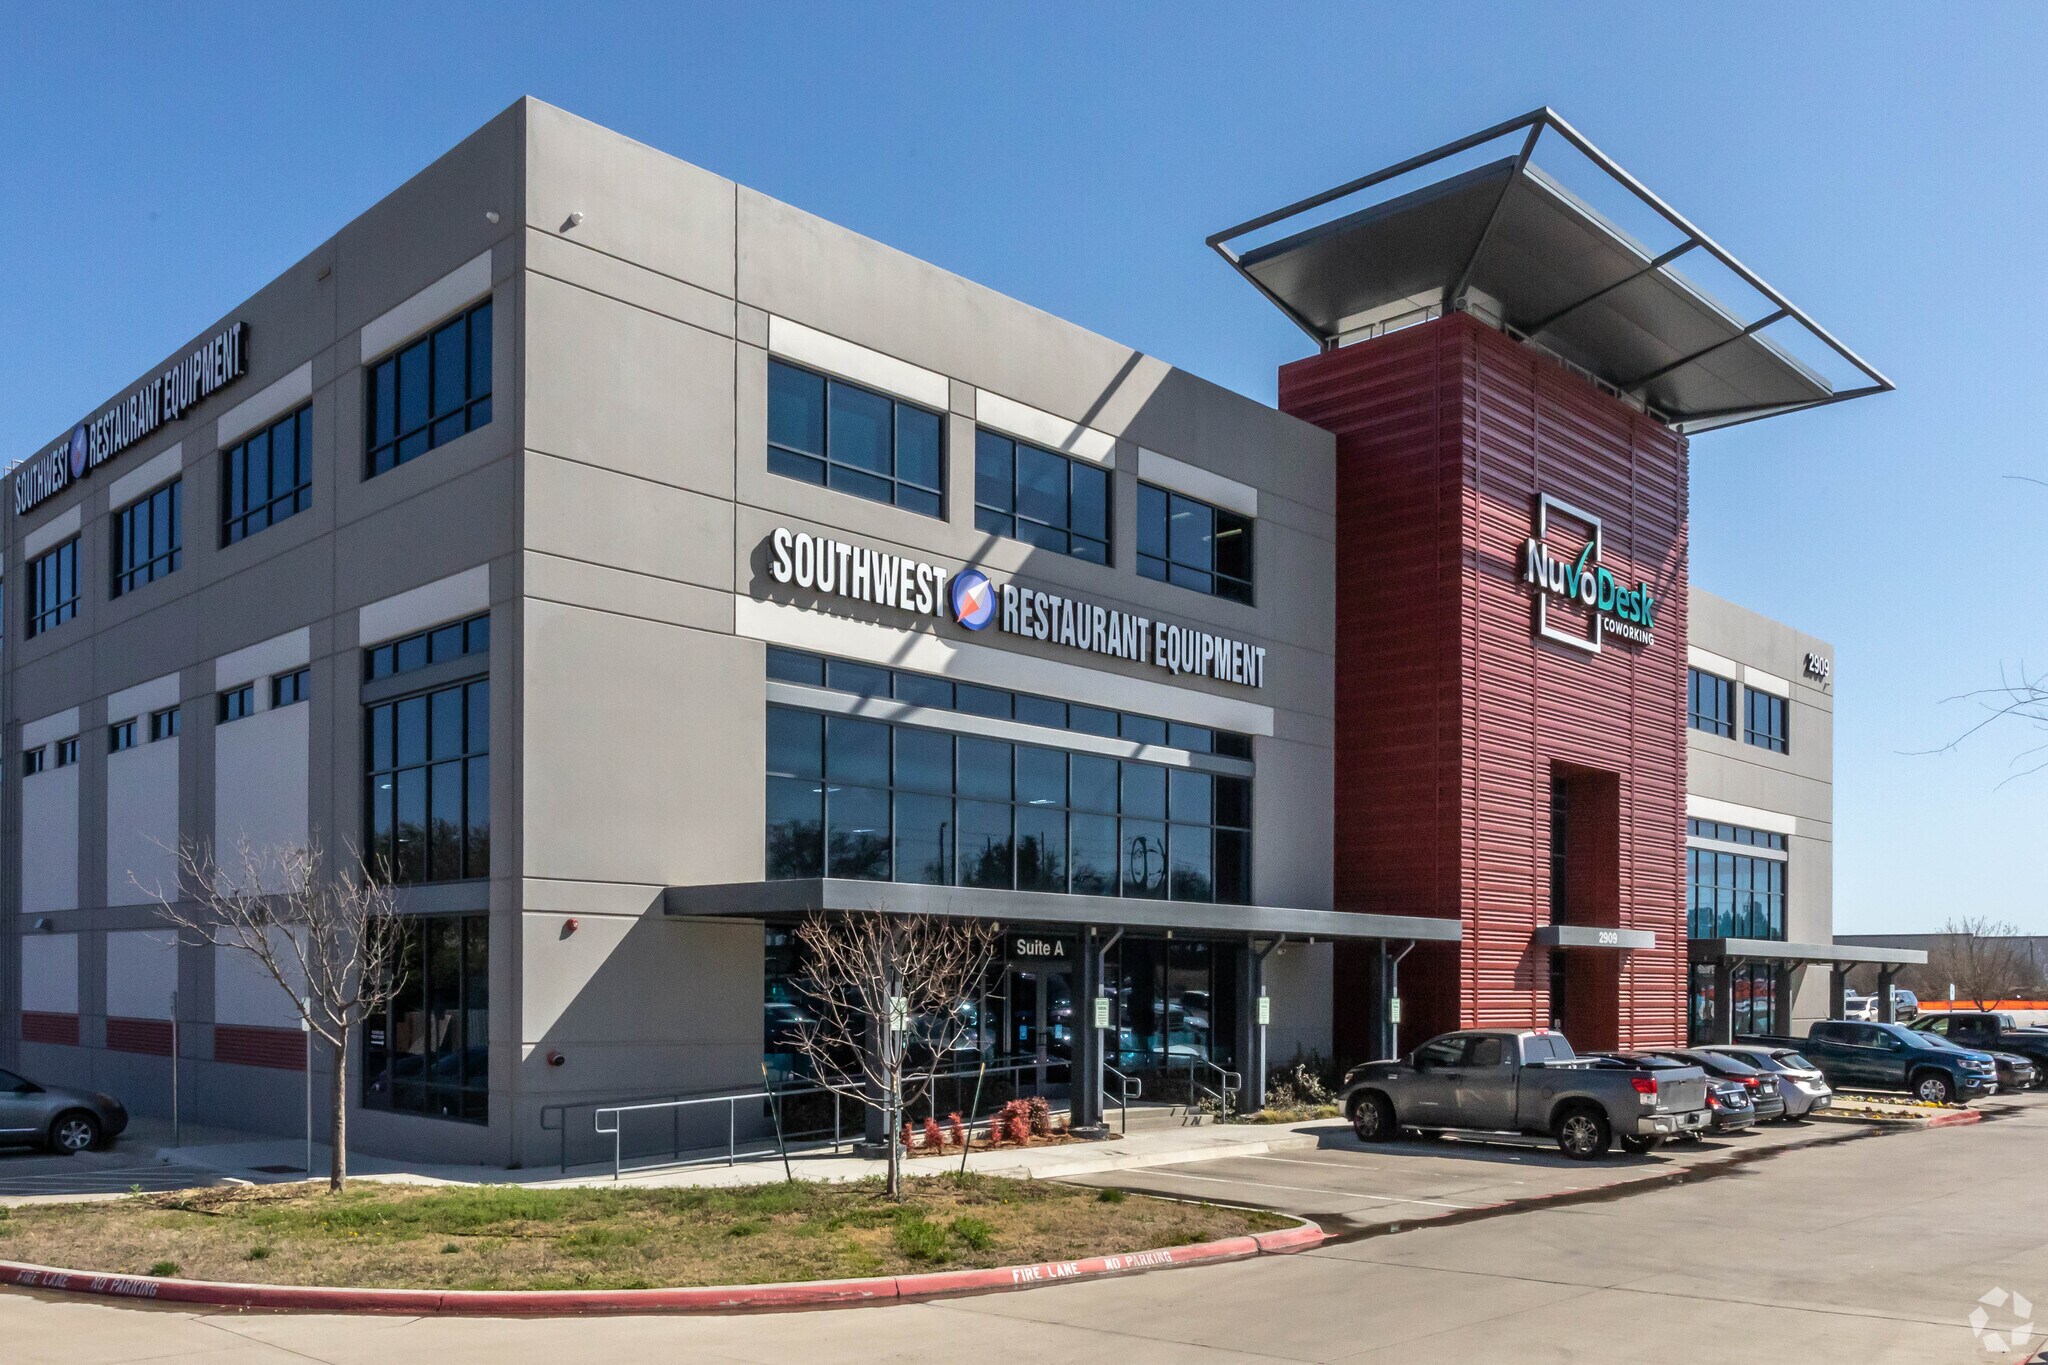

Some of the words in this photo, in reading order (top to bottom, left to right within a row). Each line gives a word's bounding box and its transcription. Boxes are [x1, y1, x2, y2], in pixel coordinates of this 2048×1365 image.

[15, 441, 70, 515] SOUTHWEST
[89, 377, 162, 468] RESTAURANT
[163, 322, 243, 419] EQUIPMENT
[771, 527, 947, 617] SOUTHWEST
[1002, 583, 1151, 663] RESTAURANT
[1154, 622, 1266, 689] EQUIPMENT
[1603, 618, 1655, 646] COWORKING
[1809, 653, 1830, 677] 2909
[1016, 938, 1051, 956] Suite
[1054, 940, 1064, 956] A
[1599, 931, 1618, 944] 2909
[1012, 1267, 1042, 1283] FIRE
[1047, 1262, 1081, 1278] LANE
[1104, 1256, 1121, 1270] NO
[1125, 1251, 1173, 1267] PARKING
[41, 1272, 72, 1288] LANE
[90, 1276, 106, 1290] NO
[109, 1279, 160, 1297] PARKING
